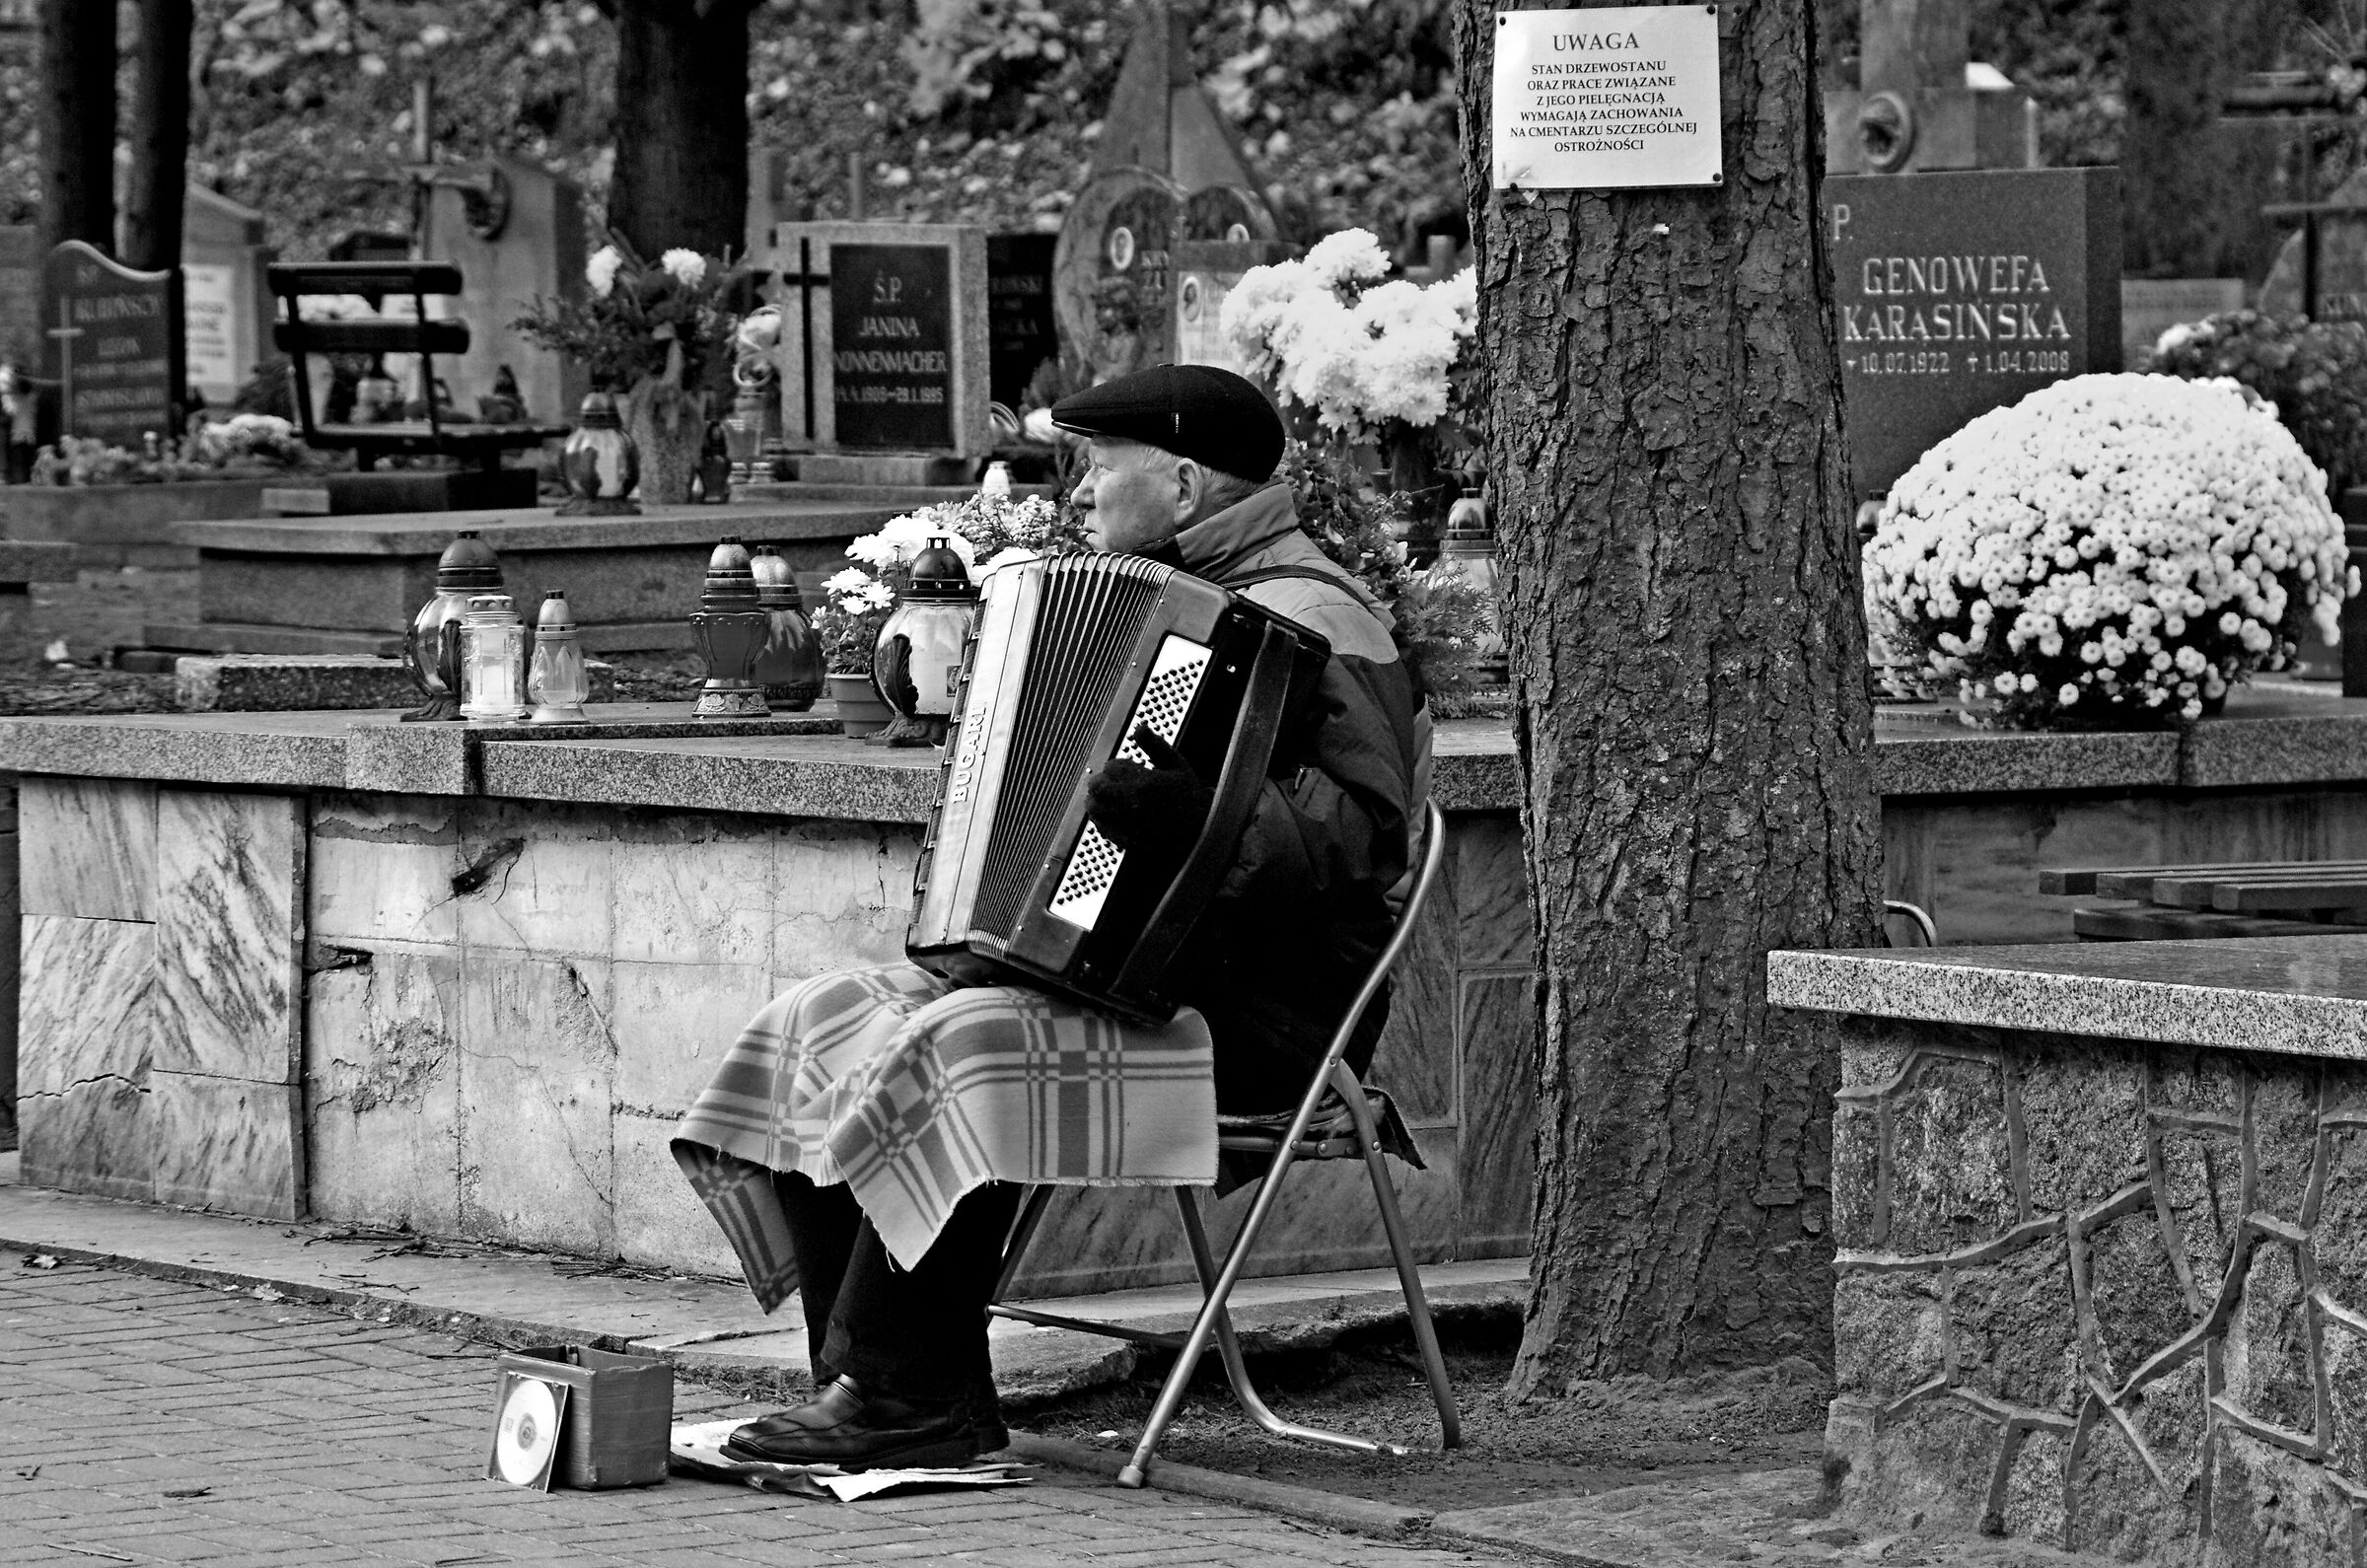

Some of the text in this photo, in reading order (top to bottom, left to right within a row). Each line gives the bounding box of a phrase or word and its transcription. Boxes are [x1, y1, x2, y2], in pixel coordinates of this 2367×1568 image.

[1553, 33, 1640, 51] UWAGA
[1532, 61, 1667, 75] STAN DRZEWOSTANU
[1528, 76, 1677, 91] ORAZ PRACE ZWIĄZANE
[1537, 92, 1666, 107] Z JEGO PIELĘGNACJĄ
[1520, 107, 1684, 123] WYMAGAJĄ ZACHOWANIA
[1510, 120, 1697, 138] NA CMENTARZU SZCZEGÓLNEJ
[1554, 137, 1644, 152] OSTROŻNOŚCI
[1862, 254, 2051, 295] GENOWEFA
[858, 316, 921, 338] JANINA
[1843, 298, 2072, 341] KARASIŃSKA
[951, 705, 987, 805] BUGARI
